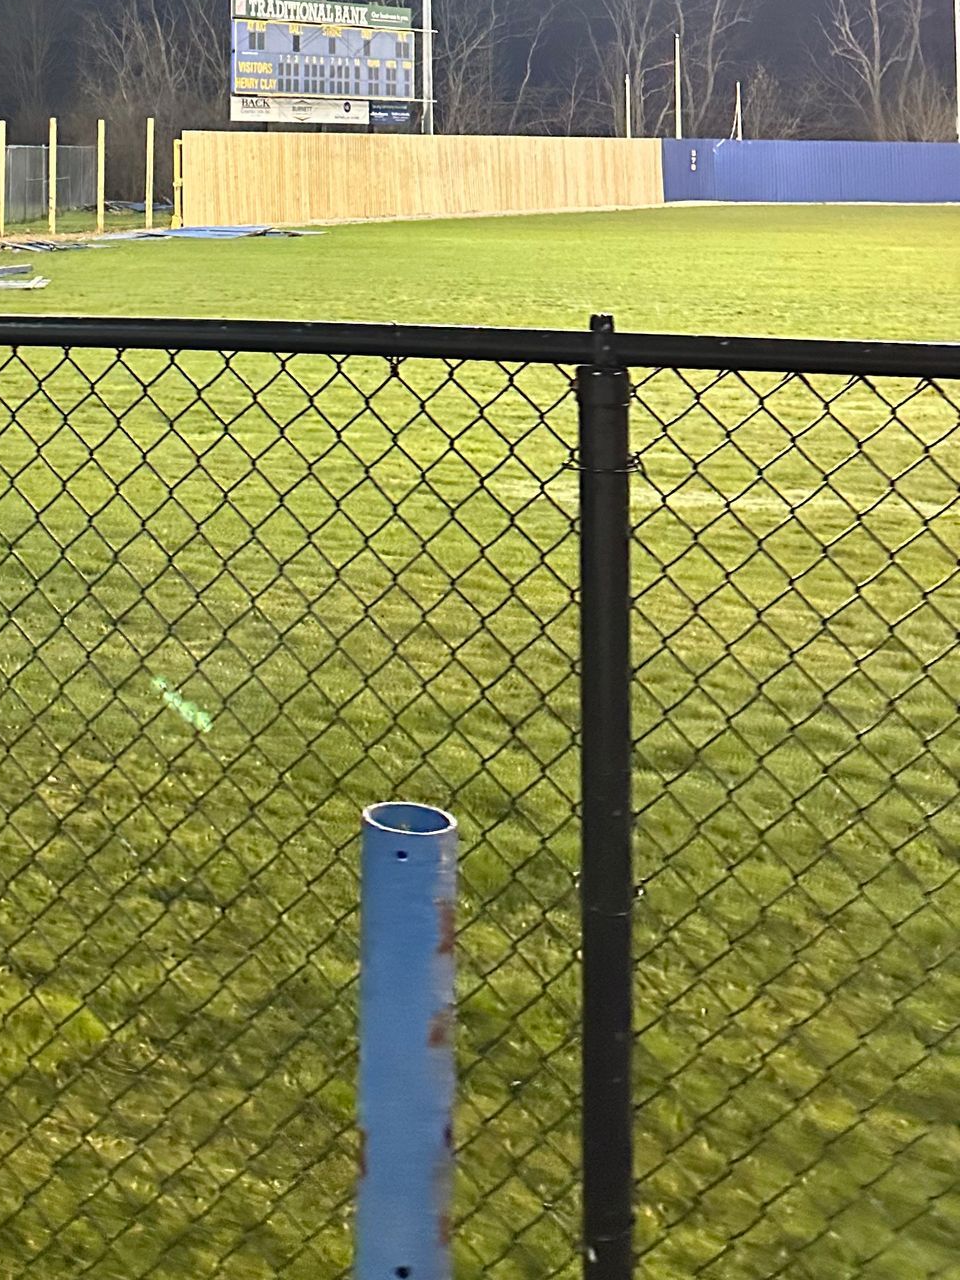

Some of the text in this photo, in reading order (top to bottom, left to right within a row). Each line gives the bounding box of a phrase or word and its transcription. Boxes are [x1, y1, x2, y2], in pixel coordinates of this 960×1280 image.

[335, 5, 368, 26] BANK
[238, 61, 273, 74] VISITORS
[236, 77, 277, 90] HENRY CLAY
[241, 98, 271, 109] BACK
